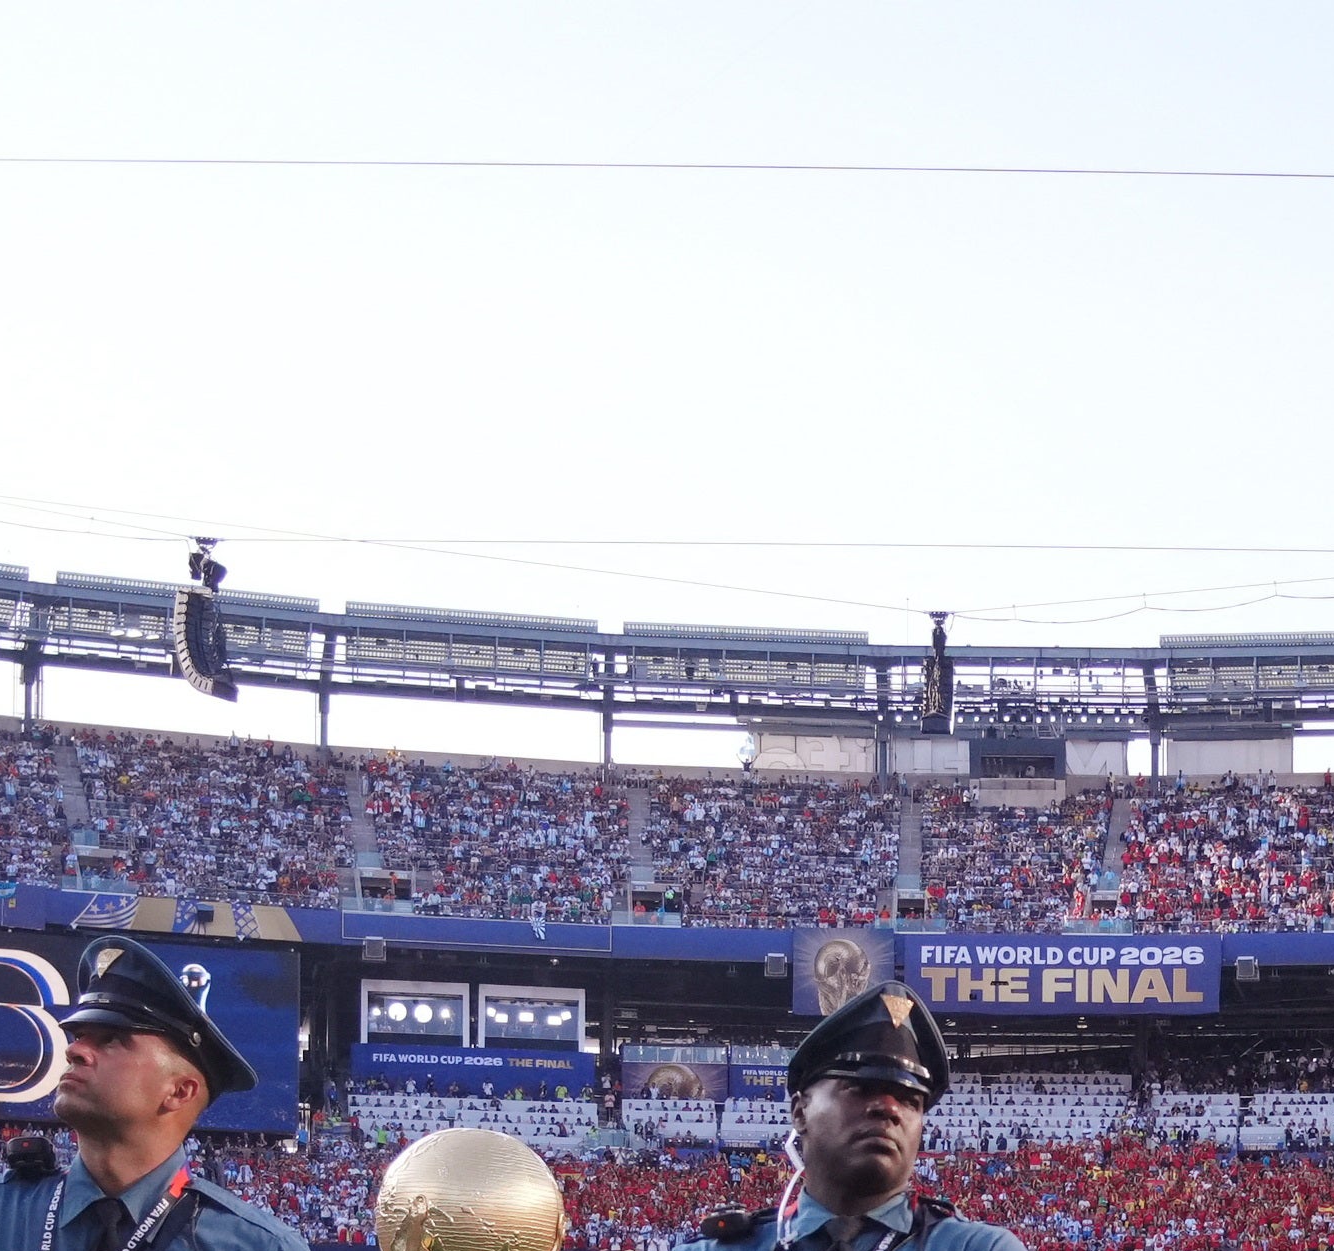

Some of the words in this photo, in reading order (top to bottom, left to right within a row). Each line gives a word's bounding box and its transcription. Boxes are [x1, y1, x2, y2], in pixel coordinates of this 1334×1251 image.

[921, 945, 972, 965] FIFA
[975, 946, 1063, 965] WORLD
[1067, 946, 1116, 965] CUP
[1120, 946, 1205, 965] 2026
[920, 967, 1029, 1002] THE
[1042, 968, 1204, 1003] FINAL
[372, 1053, 397, 1063] FIFA
[398, 1054, 439, 1064] WORLD
[440, 1055, 463, 1065] CUP
[464, 1056, 503, 1066] 2026
[507, 1058, 533, 1068] THE
[535, 1058, 575, 1069] FINAL
[742, 1075, 774, 1086] THE
[49, 1180, 64, 1211] 2026
[152, 1198, 169, 1219] FIFA
[45, 1211, 57, 1231] CUP
